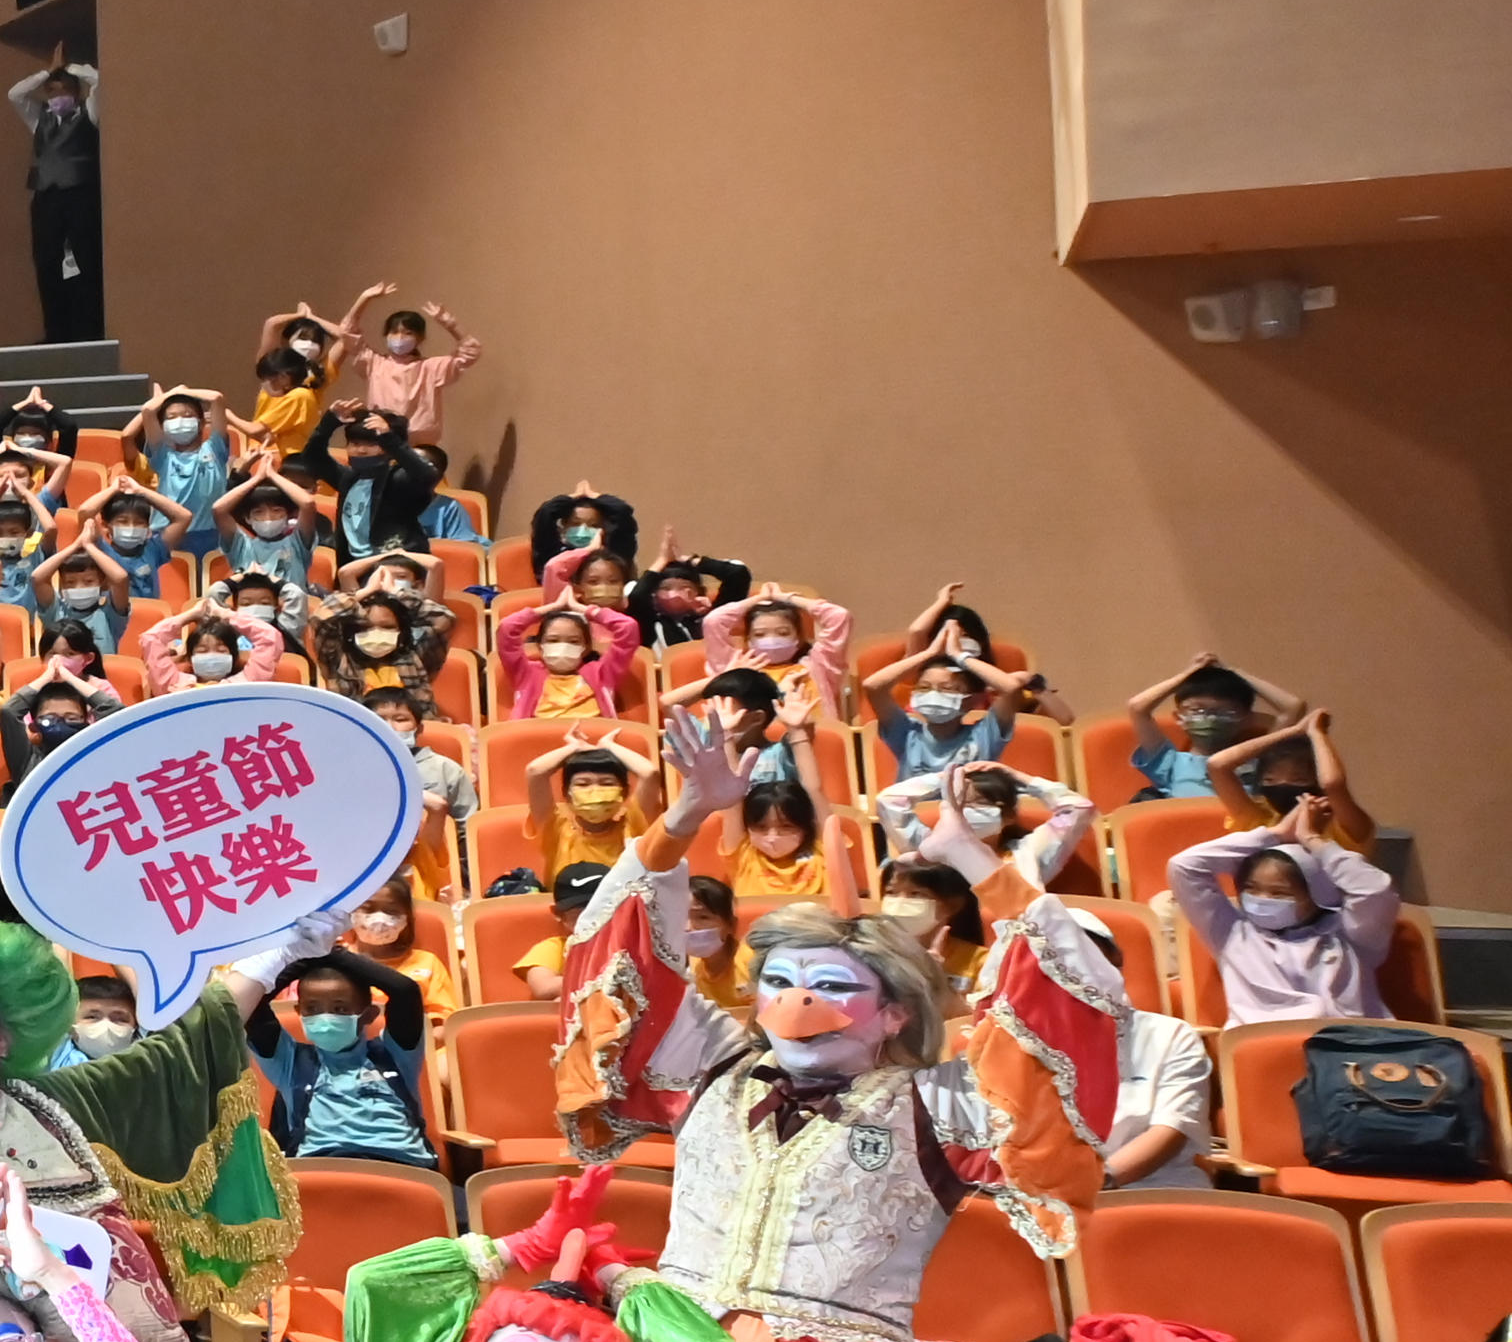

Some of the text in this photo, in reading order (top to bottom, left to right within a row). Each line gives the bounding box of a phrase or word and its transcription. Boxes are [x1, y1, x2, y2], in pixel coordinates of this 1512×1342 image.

[59, 723, 319, 870] 兒童節
[139, 815, 319, 934] 快樂
